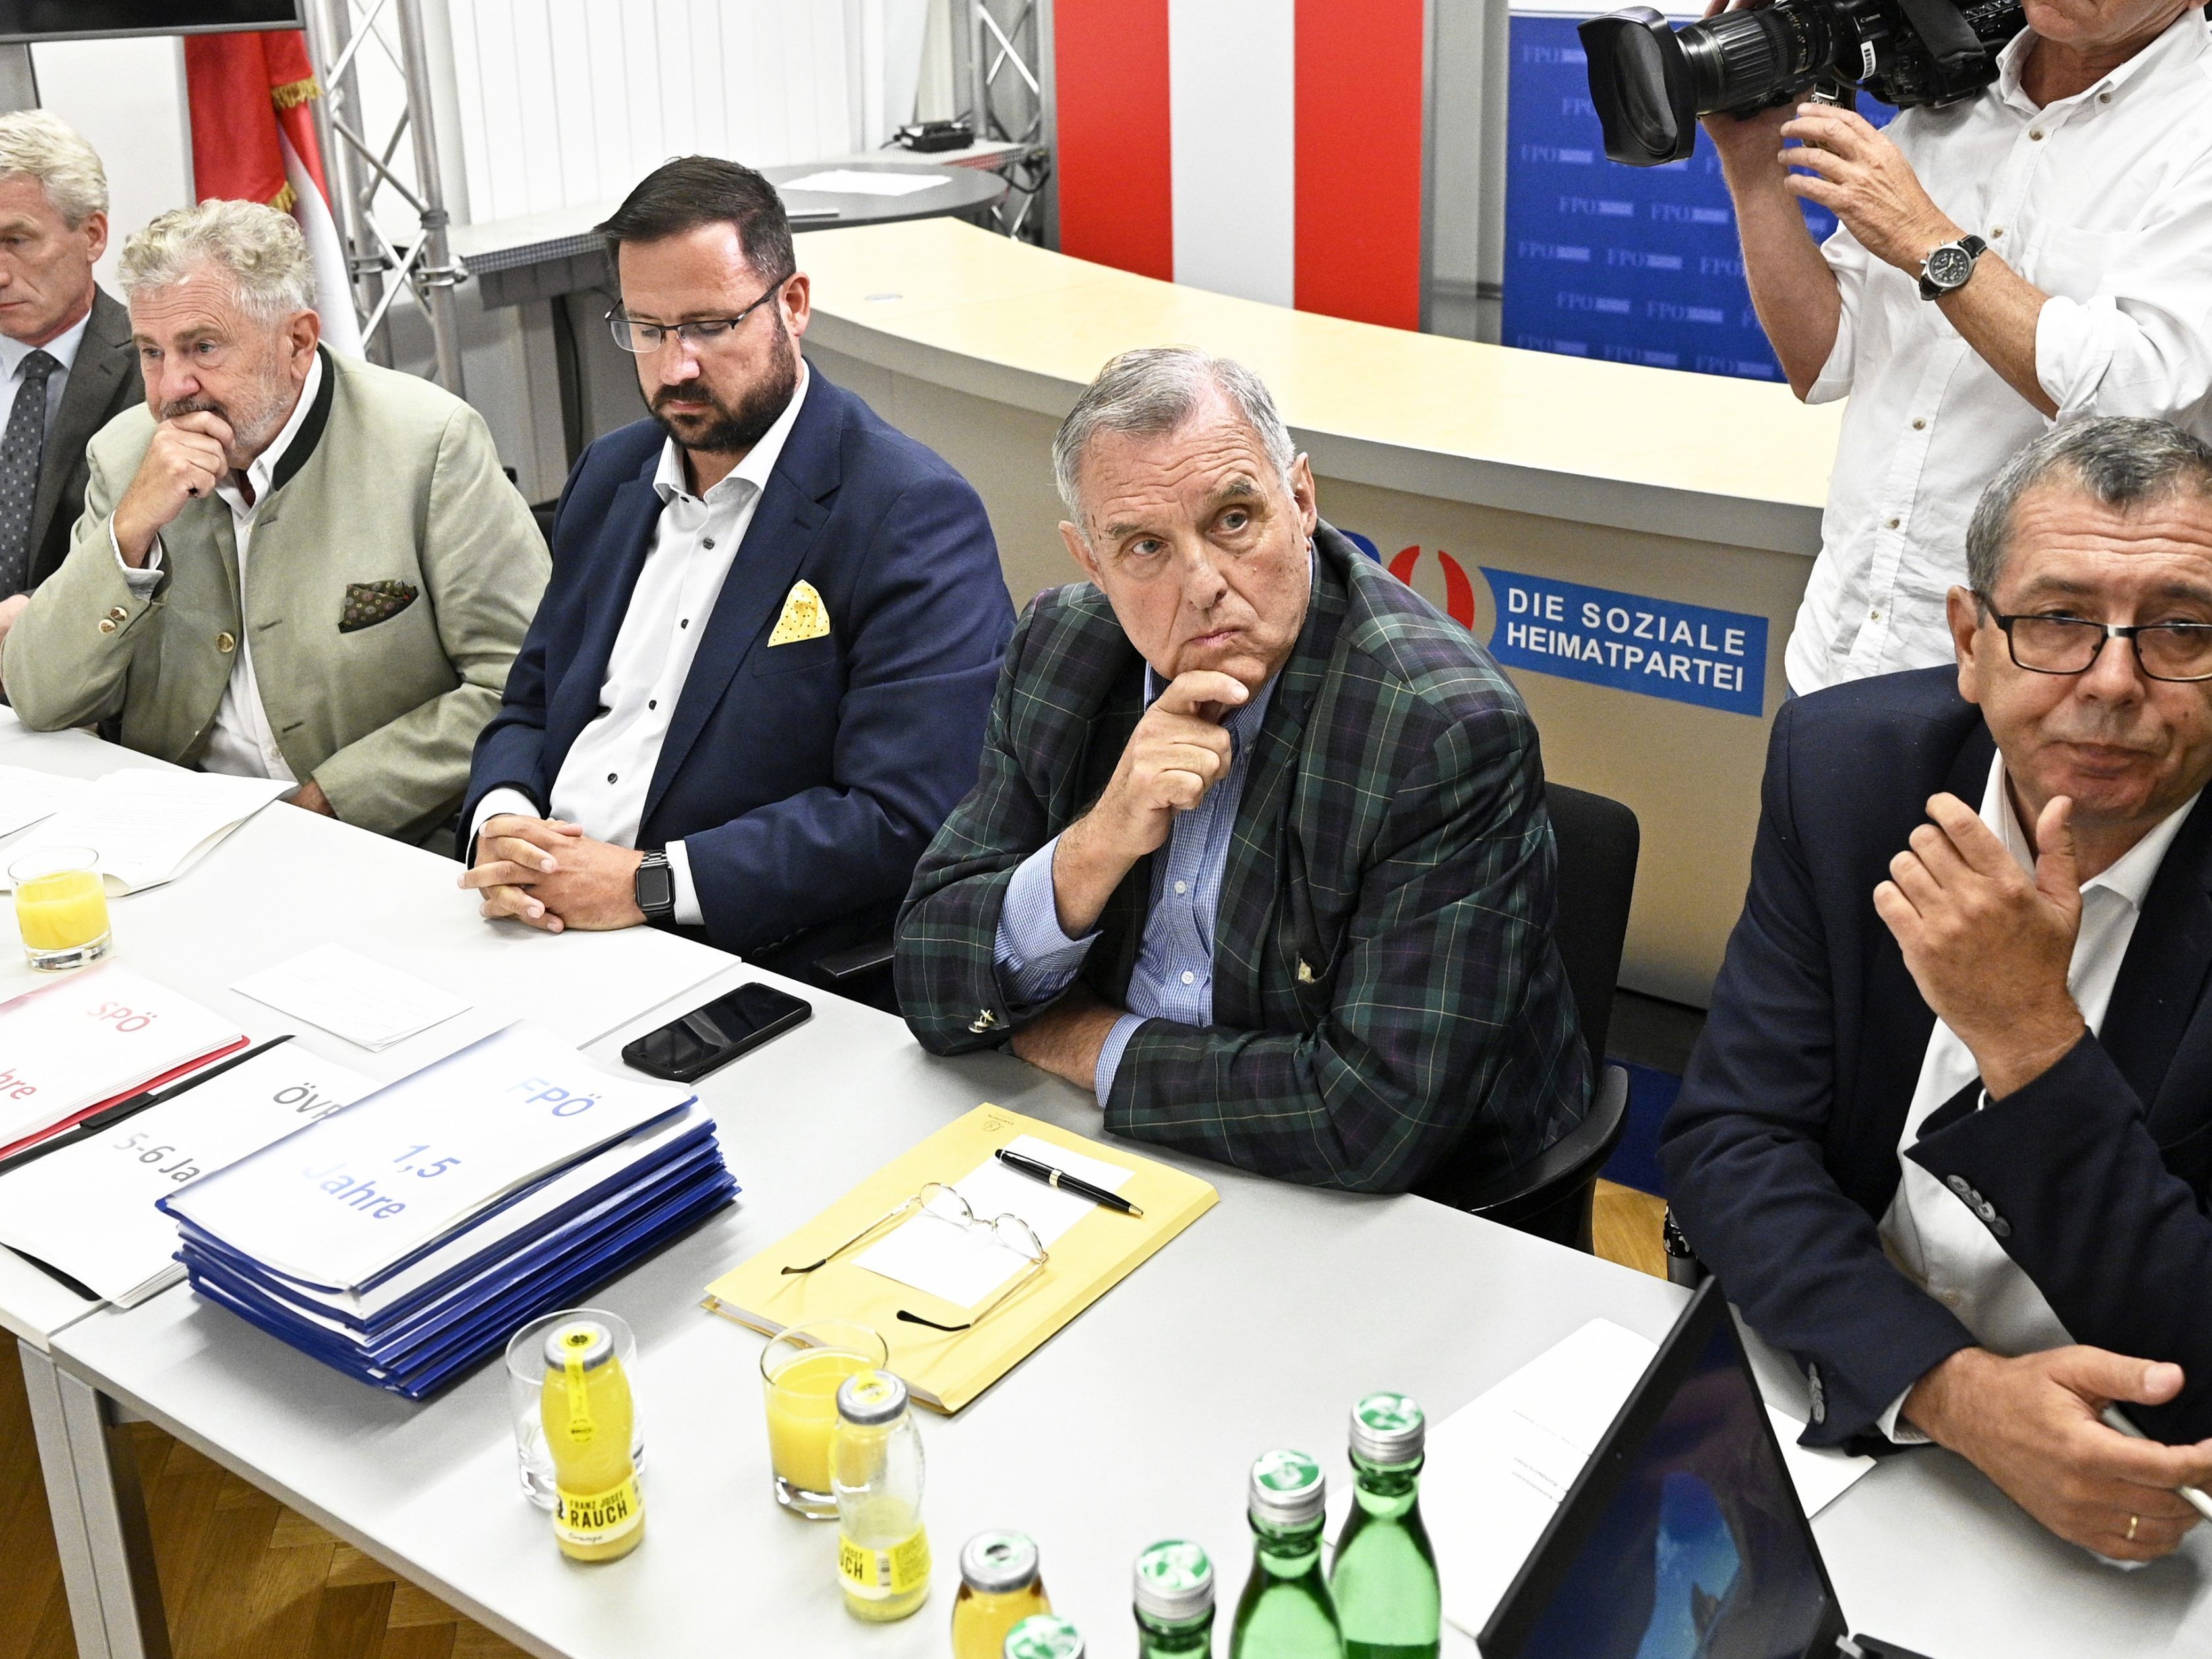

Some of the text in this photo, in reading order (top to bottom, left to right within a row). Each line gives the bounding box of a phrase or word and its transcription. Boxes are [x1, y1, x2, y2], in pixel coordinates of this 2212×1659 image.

[1860, 13, 1880, 24] Canon
[1509, 587, 1745, 656] DIE SOZIALE
[1507, 621, 1743, 692] HEIMATPARTEI
[86, 1002, 158, 1032] SPÖ
[0, 1068, 37, 1099] hre
[505, 1076, 603, 1116] FPÖ
[112, 1132, 200, 1182] 5-6 Ja
[394, 1145, 462, 1178] 1,5
[302, 1162, 406, 1219] Jahre
[570, 1500, 628, 1528] RAUCH
[839, 1553, 863, 1580] UCH
